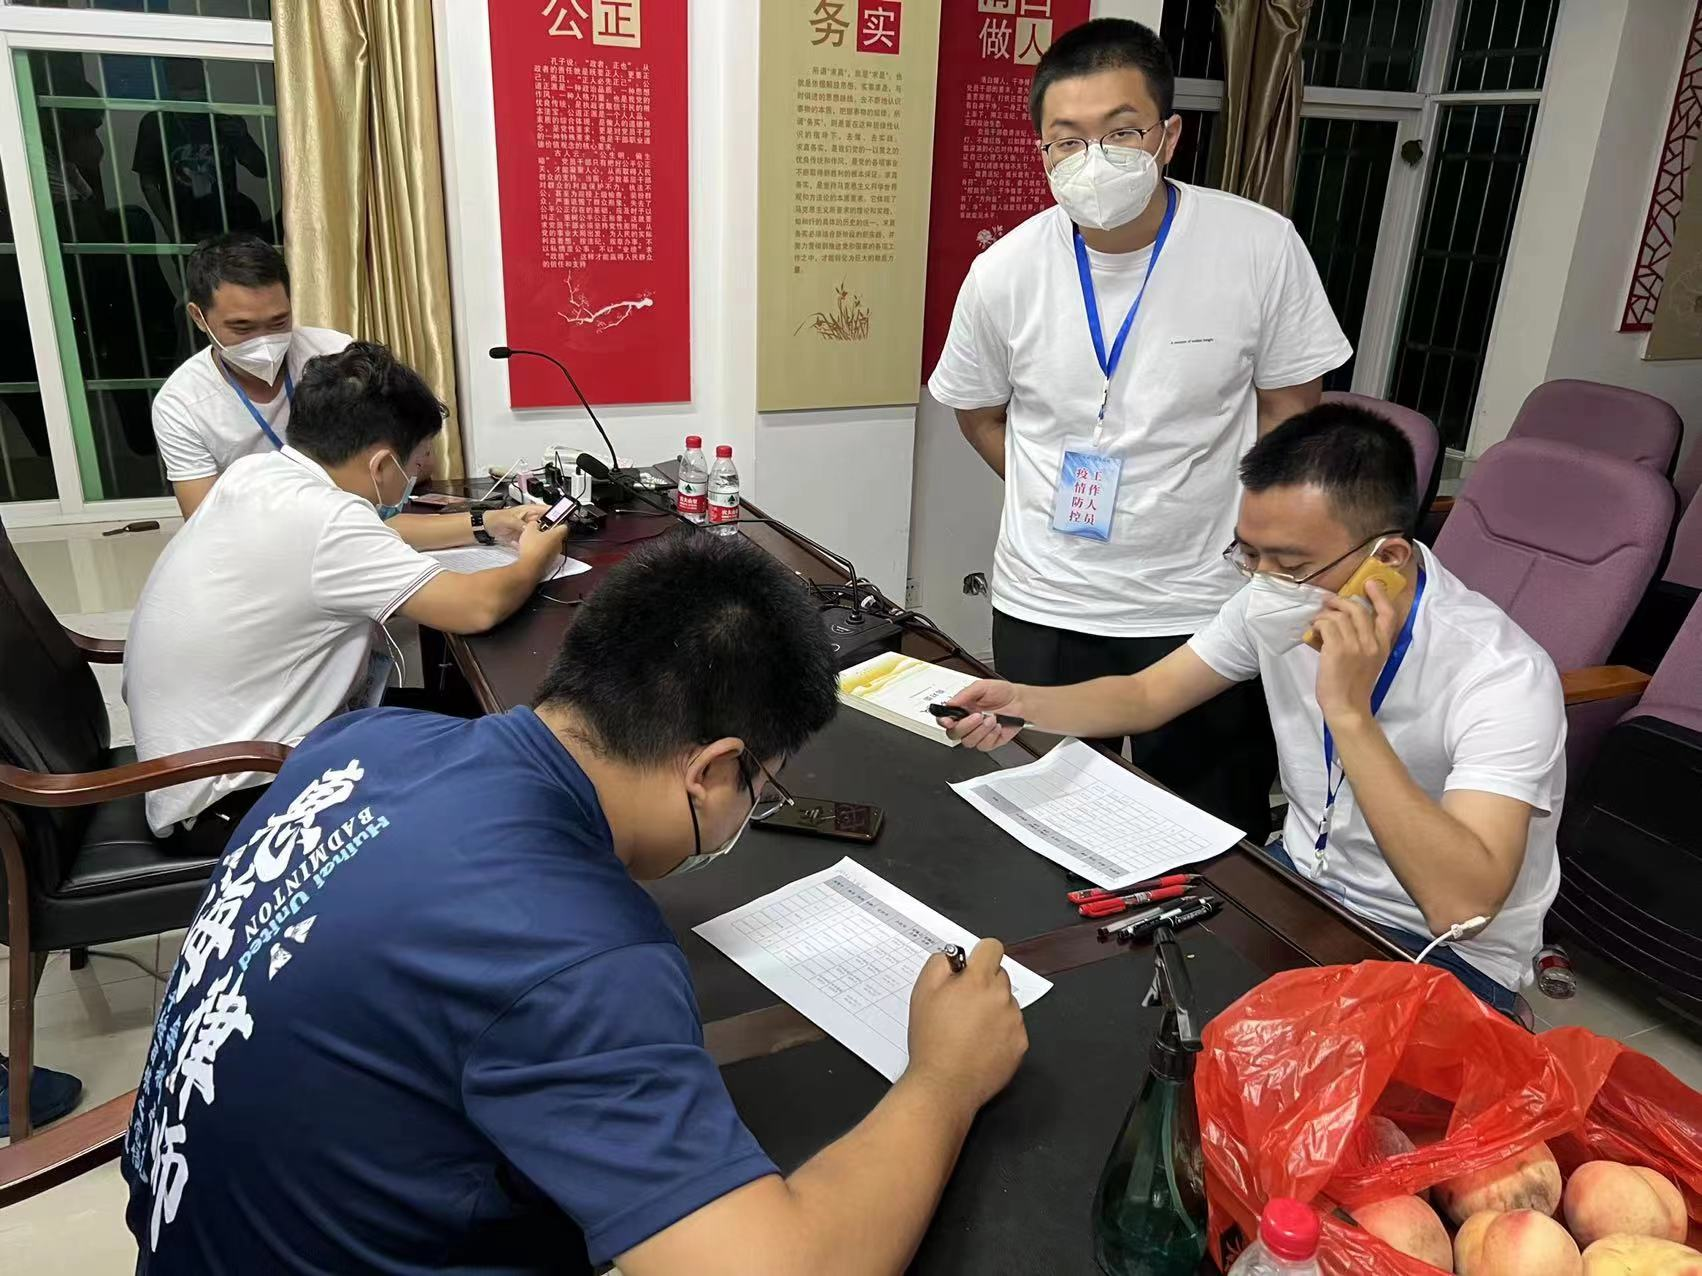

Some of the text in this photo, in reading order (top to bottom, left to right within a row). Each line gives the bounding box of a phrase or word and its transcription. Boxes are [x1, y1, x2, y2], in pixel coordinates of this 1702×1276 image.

[542, 0, 635, 40] 公正
[809, 0, 895, 48] 务实
[979, 18, 1044, 59] 做人
[1068, 467, 1089, 523] 疫情防控
[1084, 470, 1103, 526] 工作人员
[237, 815, 390, 973] Huihai United
[244, 806, 375, 942] BADMINTON
